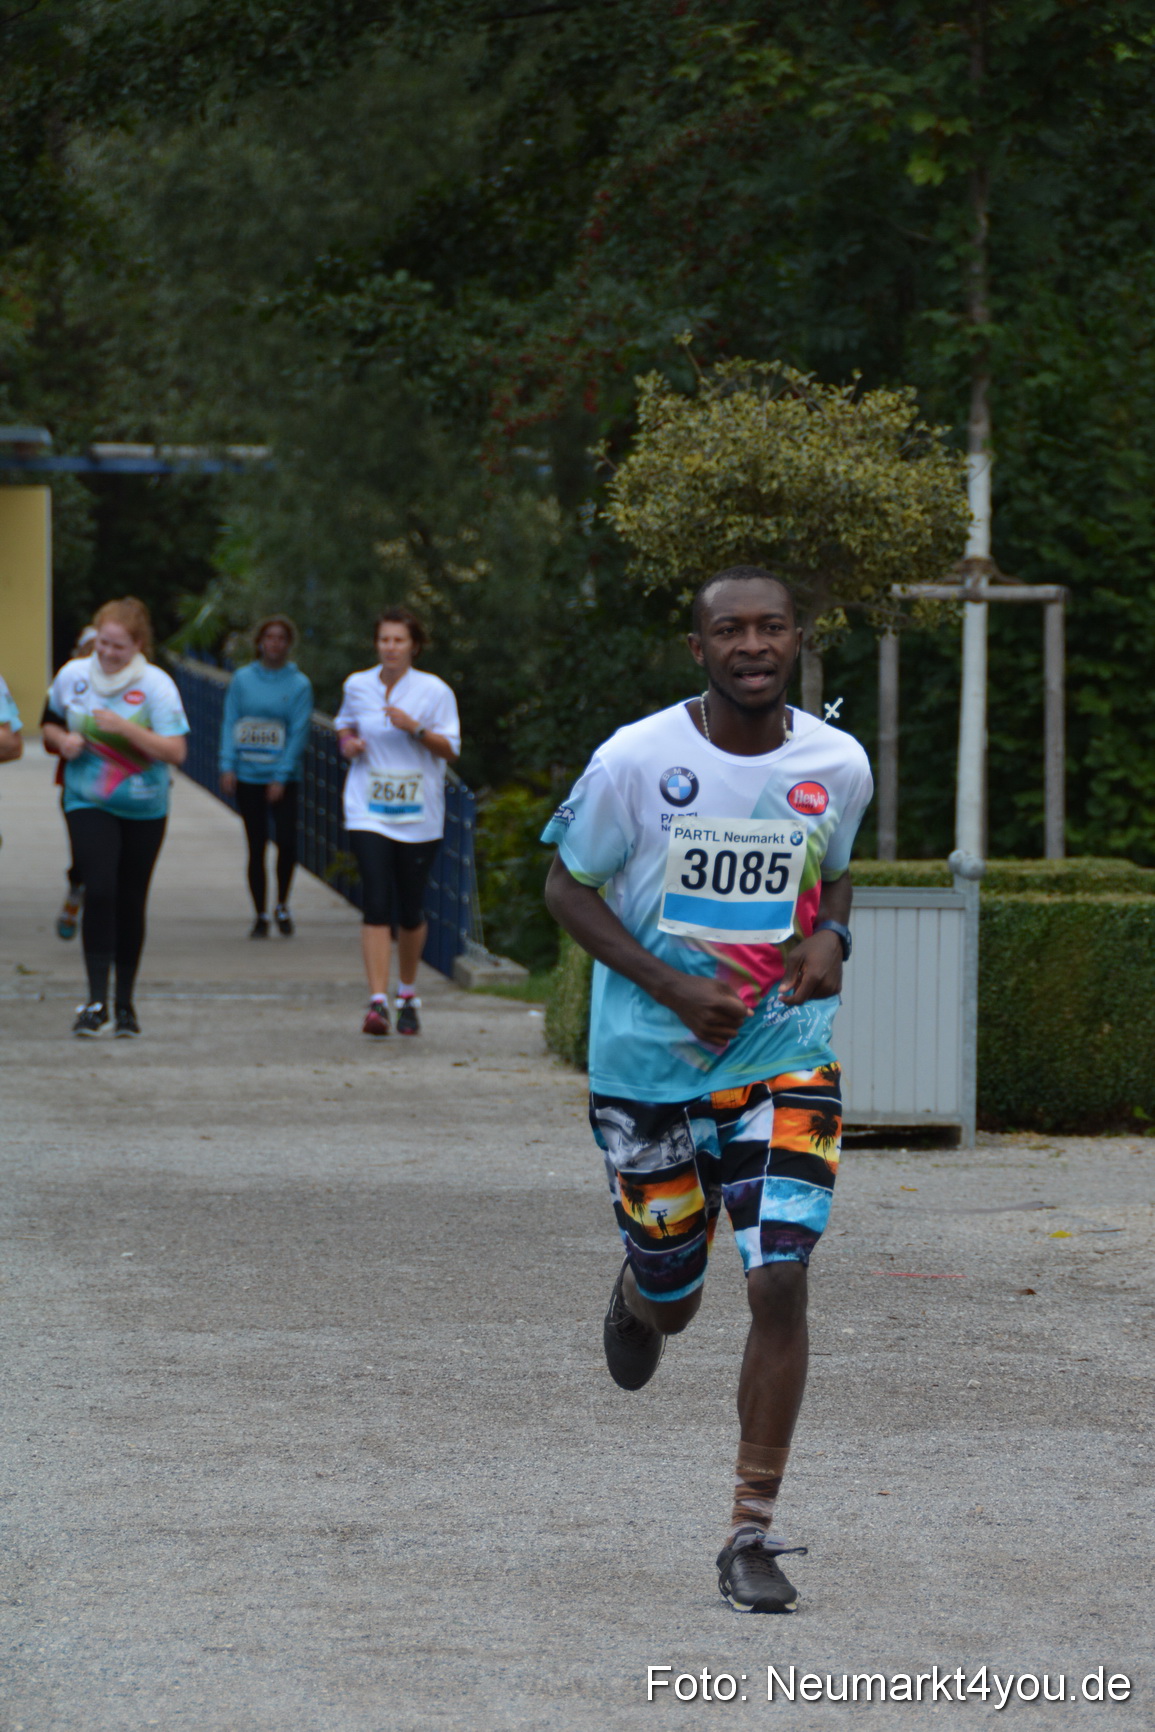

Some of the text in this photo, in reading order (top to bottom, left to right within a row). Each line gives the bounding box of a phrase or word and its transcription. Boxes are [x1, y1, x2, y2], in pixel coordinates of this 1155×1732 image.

[663, 768, 696, 781] BMW
[372, 780, 419, 802] 2647
[793, 789, 825, 808] Hervis
[674, 827, 721, 842] PARTL
[723, 831, 785, 844] Neumarkt
[680, 848, 793, 895] 3085
